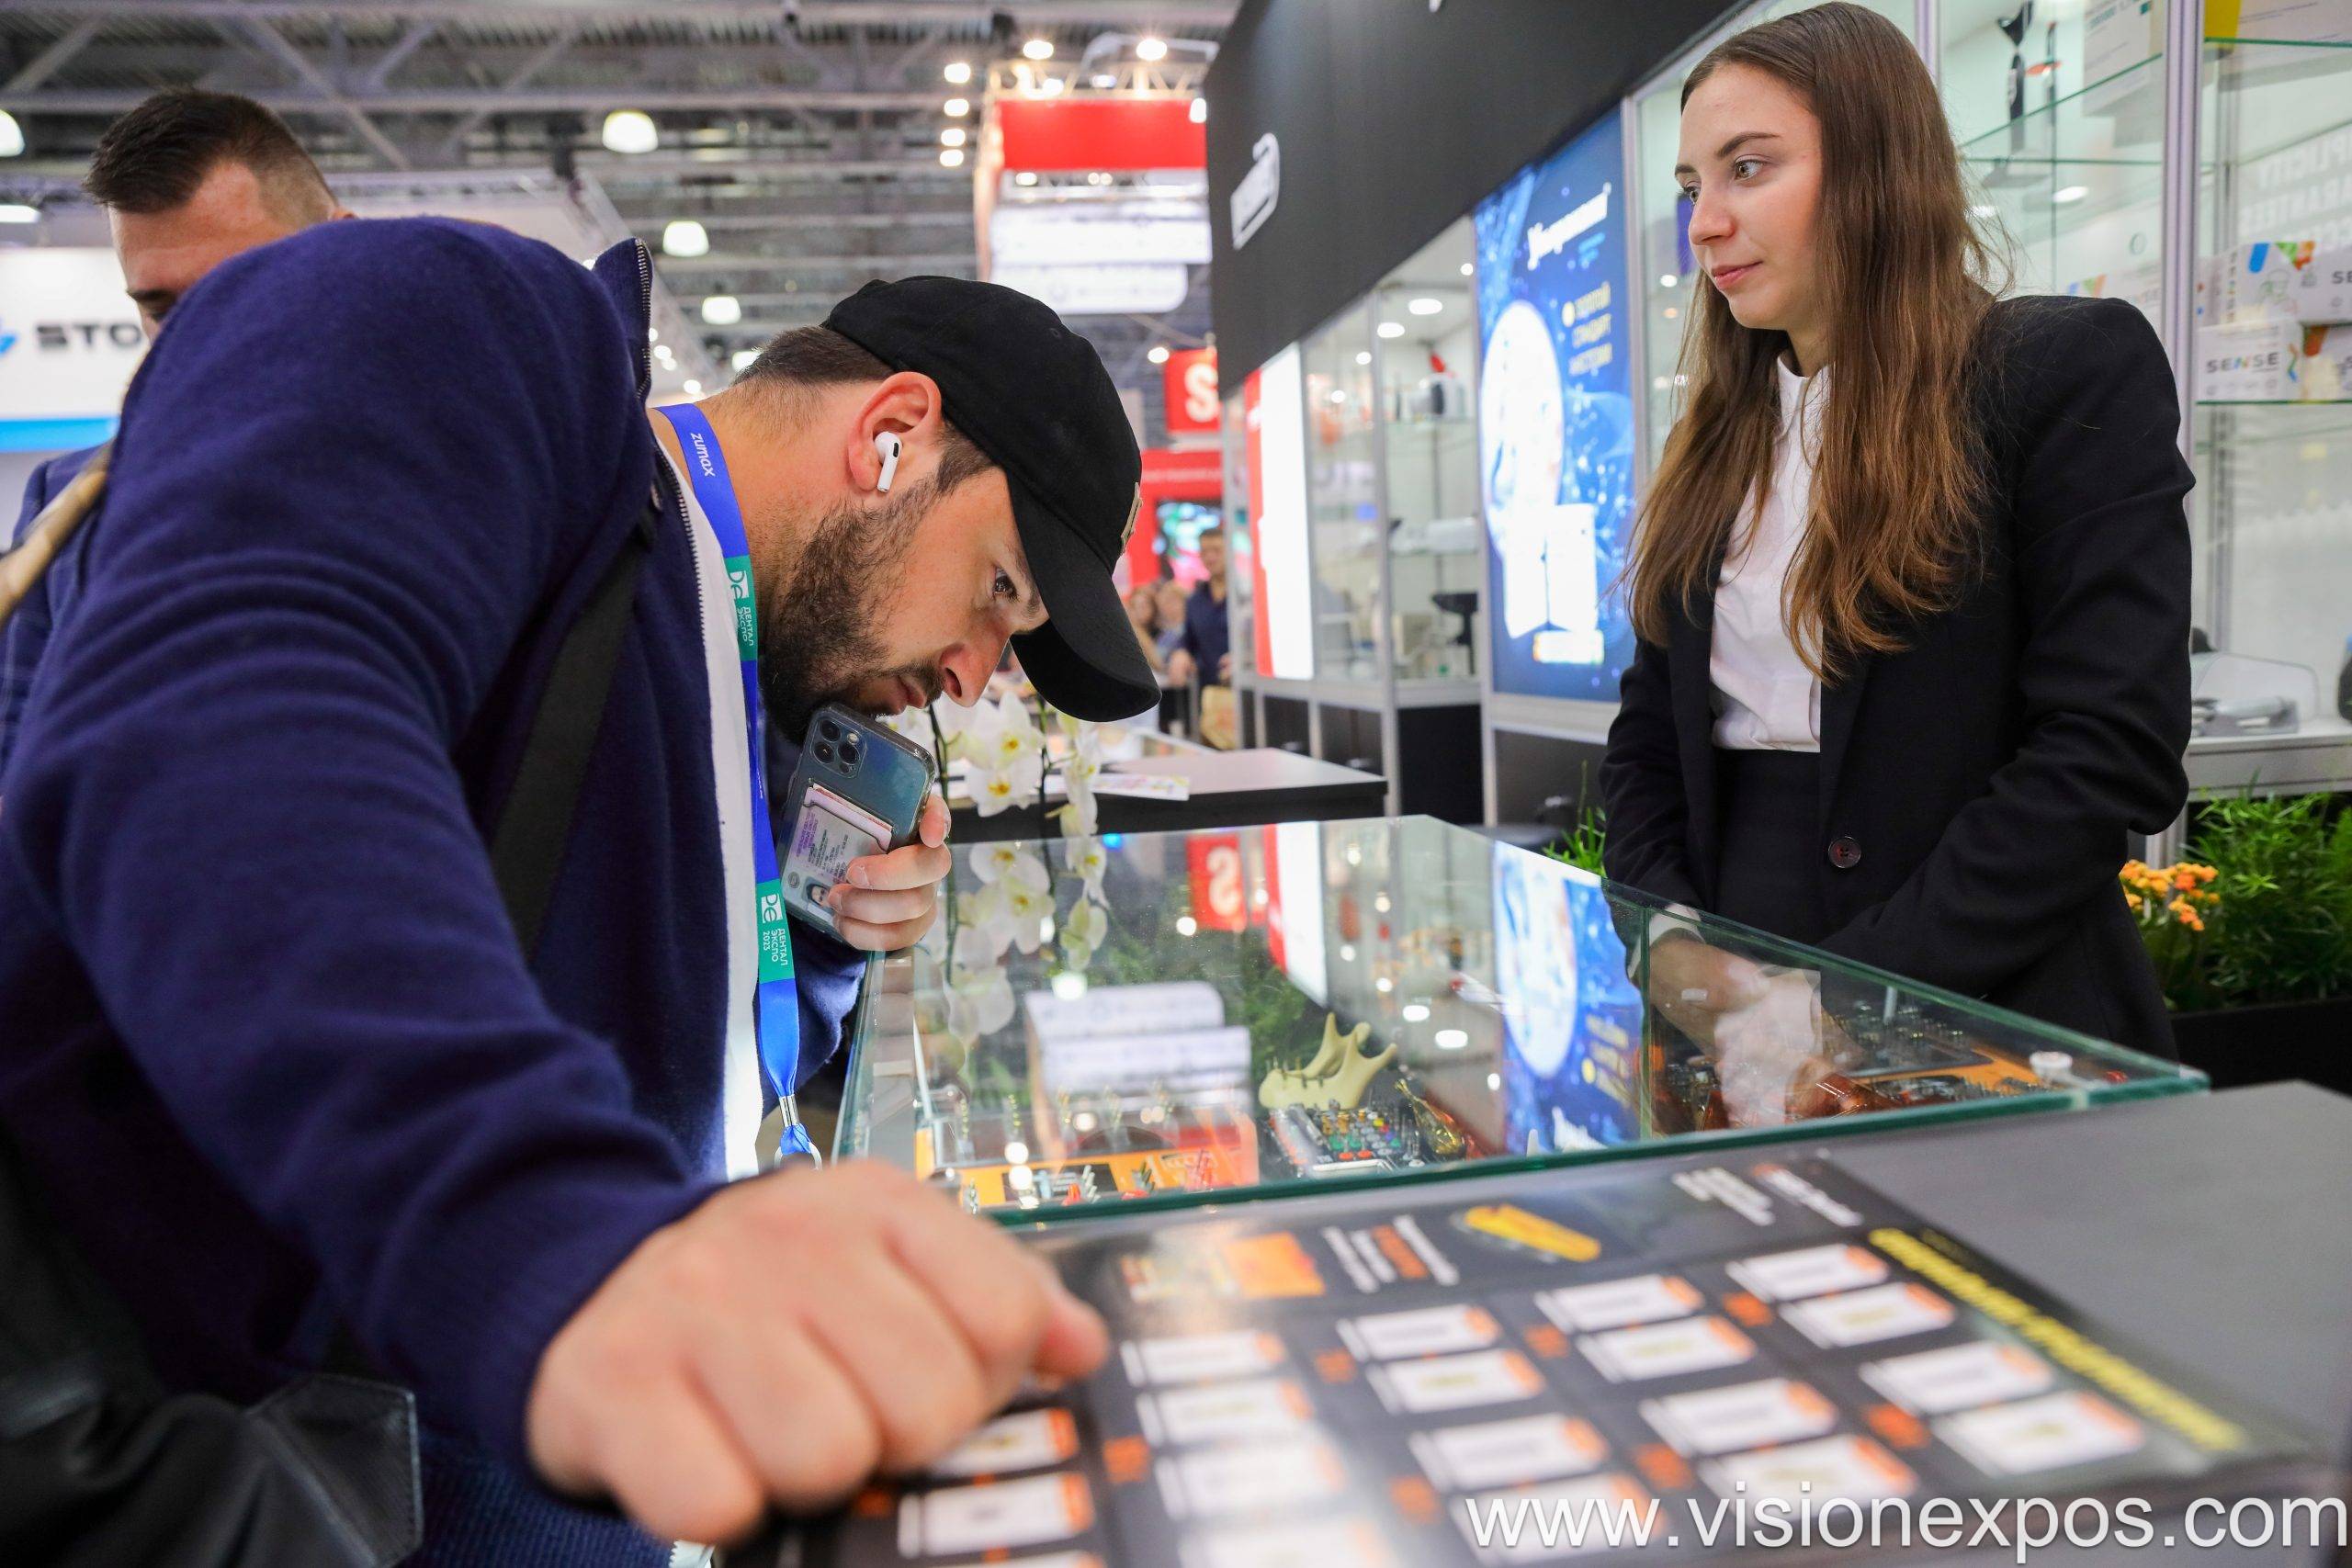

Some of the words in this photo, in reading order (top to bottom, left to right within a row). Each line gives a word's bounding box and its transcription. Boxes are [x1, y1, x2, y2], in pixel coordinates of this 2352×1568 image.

[2207, 352, 2278, 374] SENSE
[691, 433, 716, 477] zumax
[738, 607, 748, 642] ЭКСПО
[744, 606, 754, 646] ДЕНТАЛ
[763, 931, 771, 951] 2023
[771, 929, 779, 963] ЭКСПО
[778, 928, 788, 966] ДЕНТАЛ
